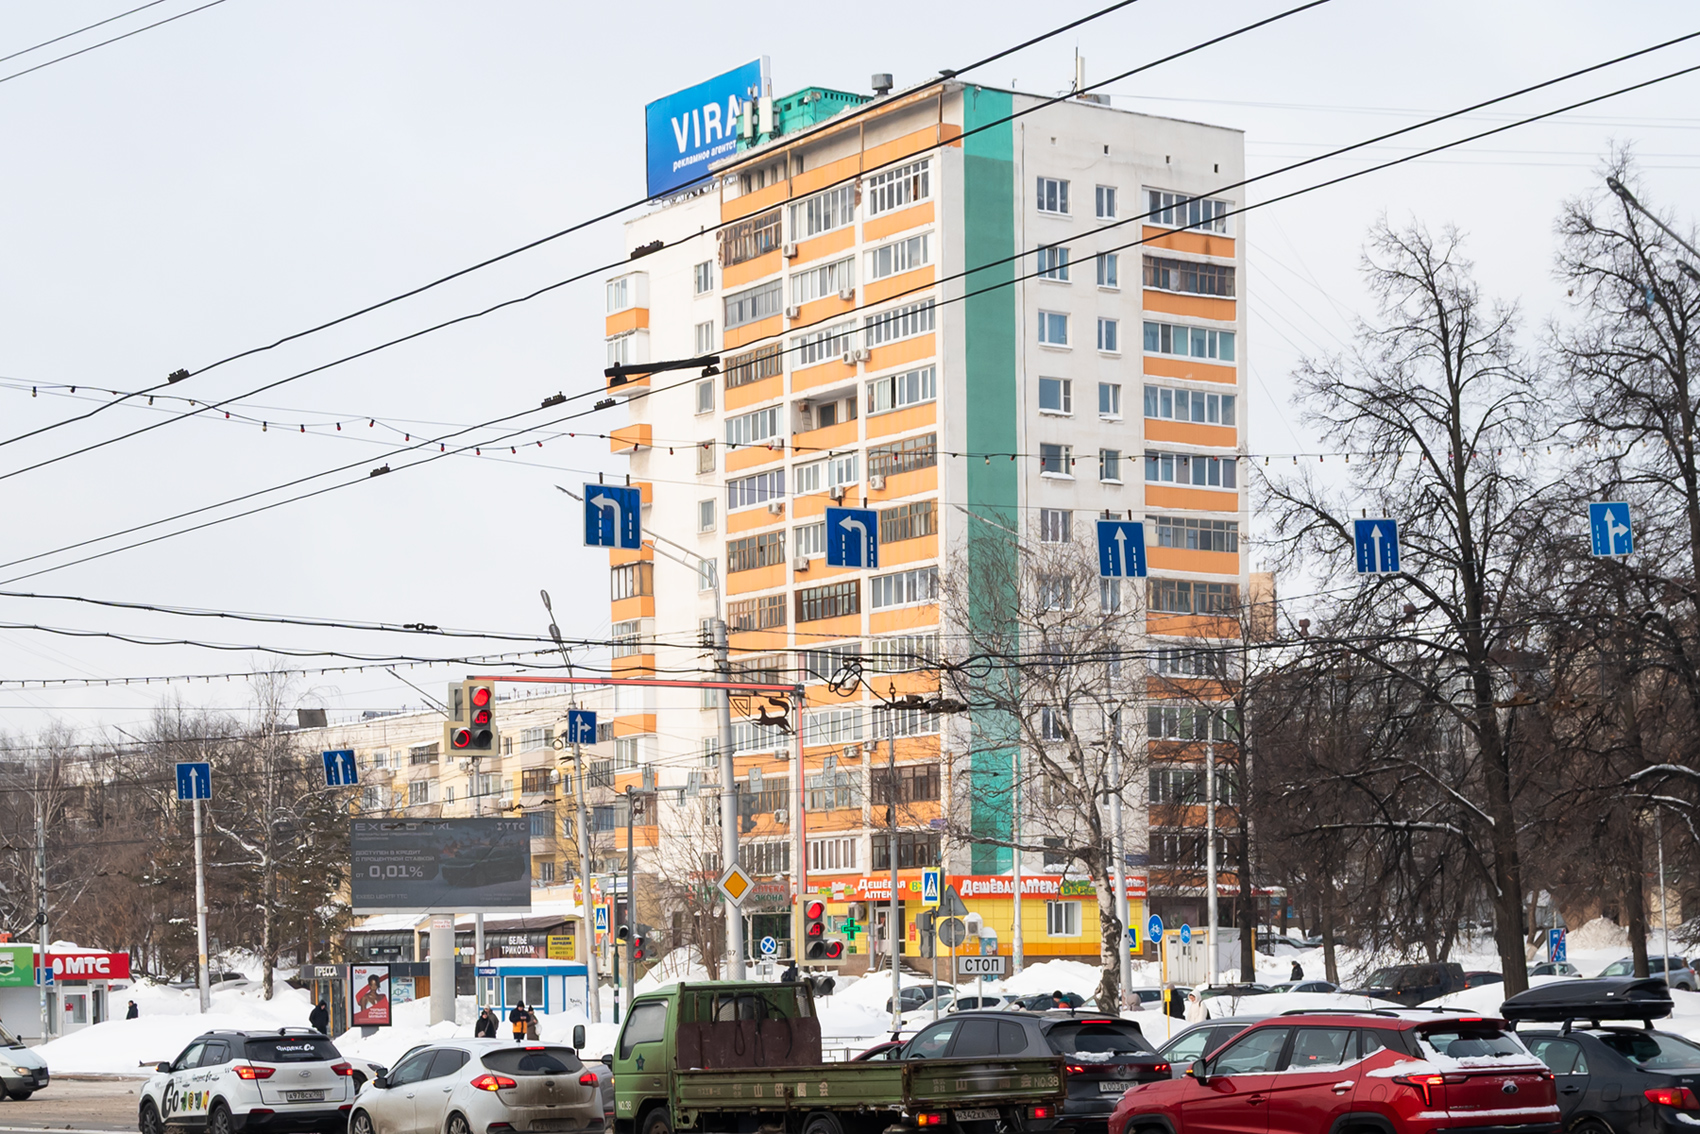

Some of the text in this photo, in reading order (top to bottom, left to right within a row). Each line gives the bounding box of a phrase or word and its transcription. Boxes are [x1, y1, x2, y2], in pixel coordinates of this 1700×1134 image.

[673, 149, 710, 173] рекламное
[752, 884, 785, 894] АПТЕКА
[960, 879, 1015, 896] ДЕШЁВА
[864, 891, 899, 899] АПТЕК
[501, 945, 535, 955] ТРИКОТАЖ
[65, 956, 110, 974] МТС
[314, 966, 338, 977] ПРЕССА
[965, 959, 999, 972] СТОП
[161, 1078, 179, 1119] Go
